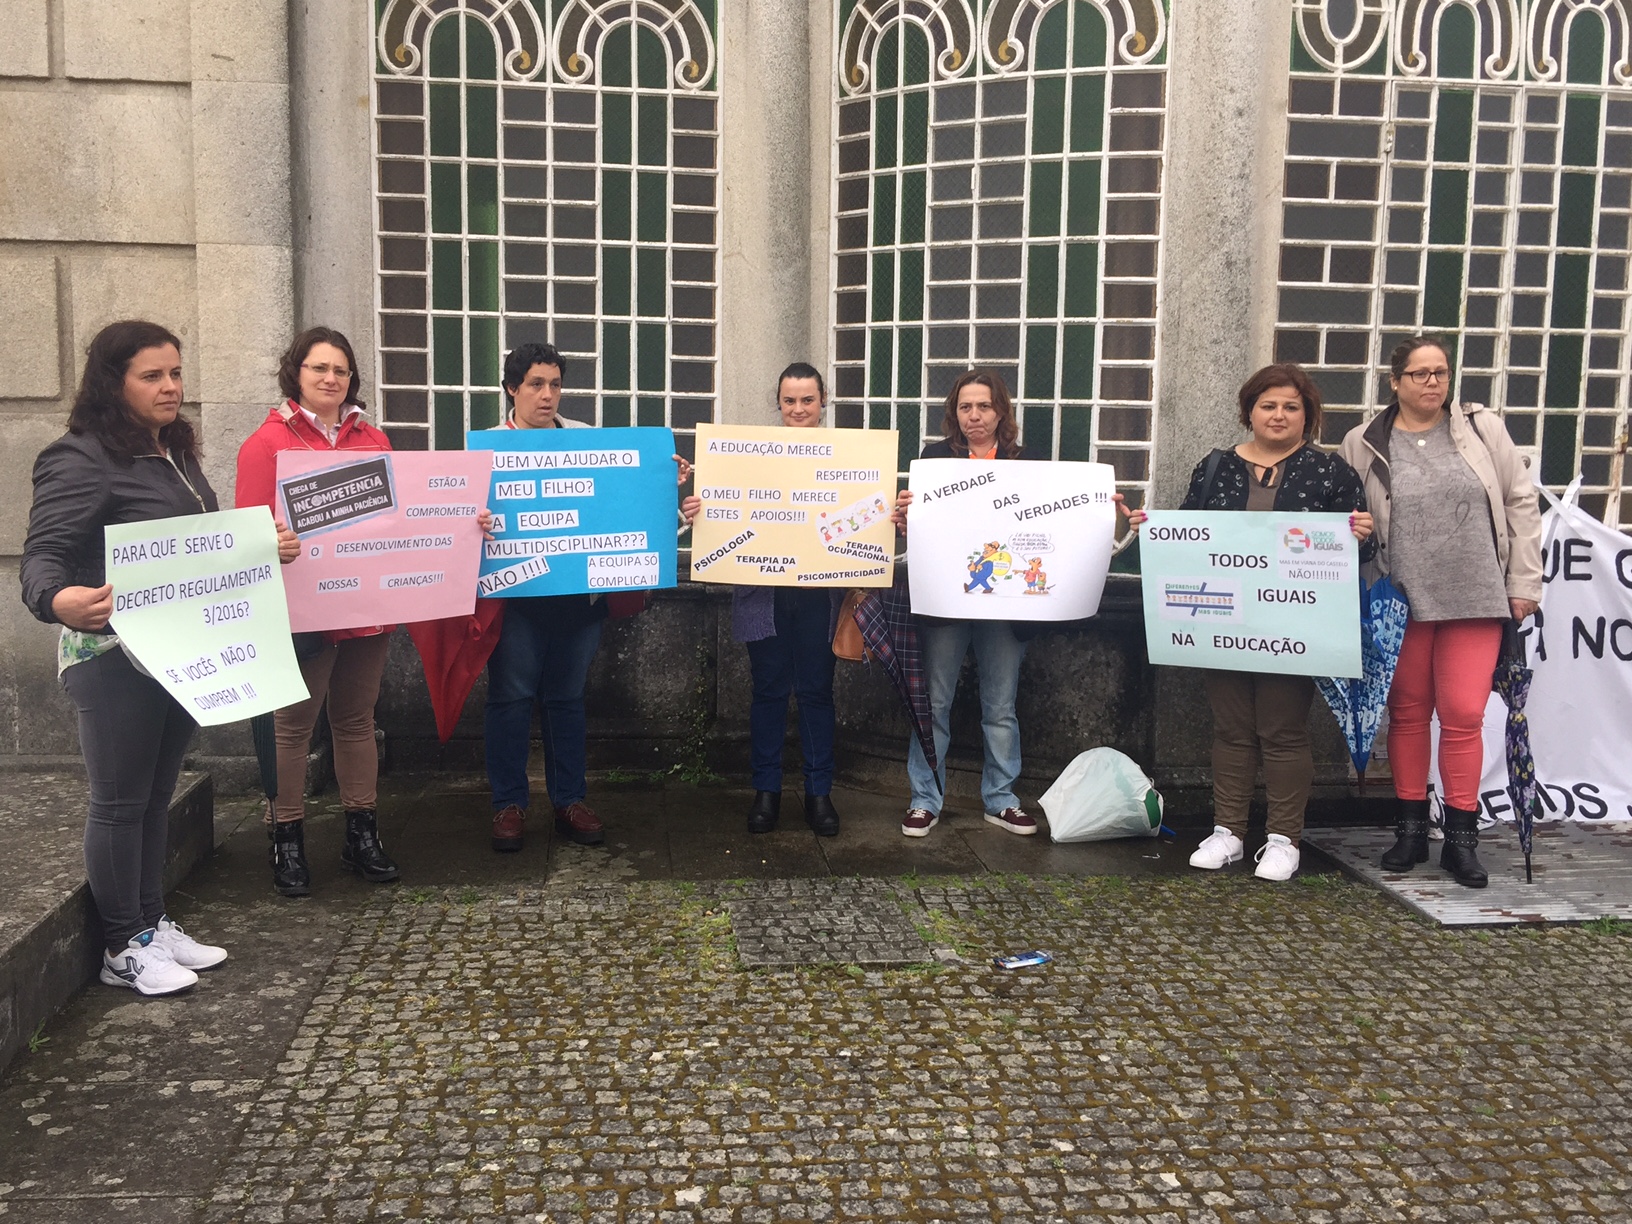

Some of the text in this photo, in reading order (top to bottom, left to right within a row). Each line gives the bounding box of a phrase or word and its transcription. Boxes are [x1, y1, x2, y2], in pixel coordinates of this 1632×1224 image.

[709, 441, 832, 456] A EDUCAÇÃO MERECE
[492, 452, 633, 470] UEM VAI AJUDAR O
[428, 477, 466, 488] ESTÃO A
[816, 470, 879, 481] RESPEITO!!!
[289, 481, 318, 496] CHEGA DE
[499, 480, 593, 497] MEU FILHO?
[702, 489, 837, 502] O MEU FILHO MERECE
[923, 471, 996, 503] A VERDADE
[993, 493, 1021, 510] DAS
[1014, 494, 1090, 522] VERDADES
[297, 495, 389, 528] ACABOU A MINHA PACIÊNCIA
[406, 506, 477, 517] COMPROMETER
[706, 509, 805, 521] ESTES APOIOS!!!
[493, 512, 575, 529] A EQUIPA
[1149, 527, 1210, 541] SOMOS
[113, 533, 234, 565] PARA QUE SERVE O
[311, 536, 452, 556] O DESENVOLVIMENTO DAS
[487, 533, 645, 556] MULTIDISCIPLINAR???
[694, 530, 755, 572] PSICOLOGIA
[846, 541, 883, 554] TERAPIA
[1314, 543, 1344, 551] IGUAIS
[588, 555, 658, 567] A EQUIPA SÓ
[735, 556, 796, 565] TERAPIA DA
[827, 545, 890, 563] OCUPACIONAL
[1209, 553, 1268, 569] TODOS
[318, 573, 444, 591] NOSSAS CRIANÇAS!!!
[479, 557, 549, 595] NÃO !!!!
[589, 575, 657, 587] COMPLICA !!
[797, 567, 886, 581] PSICOMOTRICIDADE
[116, 564, 272, 612] DECRETO REGULAMENTAR
[1257, 588, 1317, 604] IGUAIS
[203, 601, 250, 625] 3/2016?
[1172, 632, 1306, 656] NA EDUCAÇÃO
[166, 644, 257, 684] SE VOCÊS NÃO O
[194, 687, 241, 710] CUMPREM
